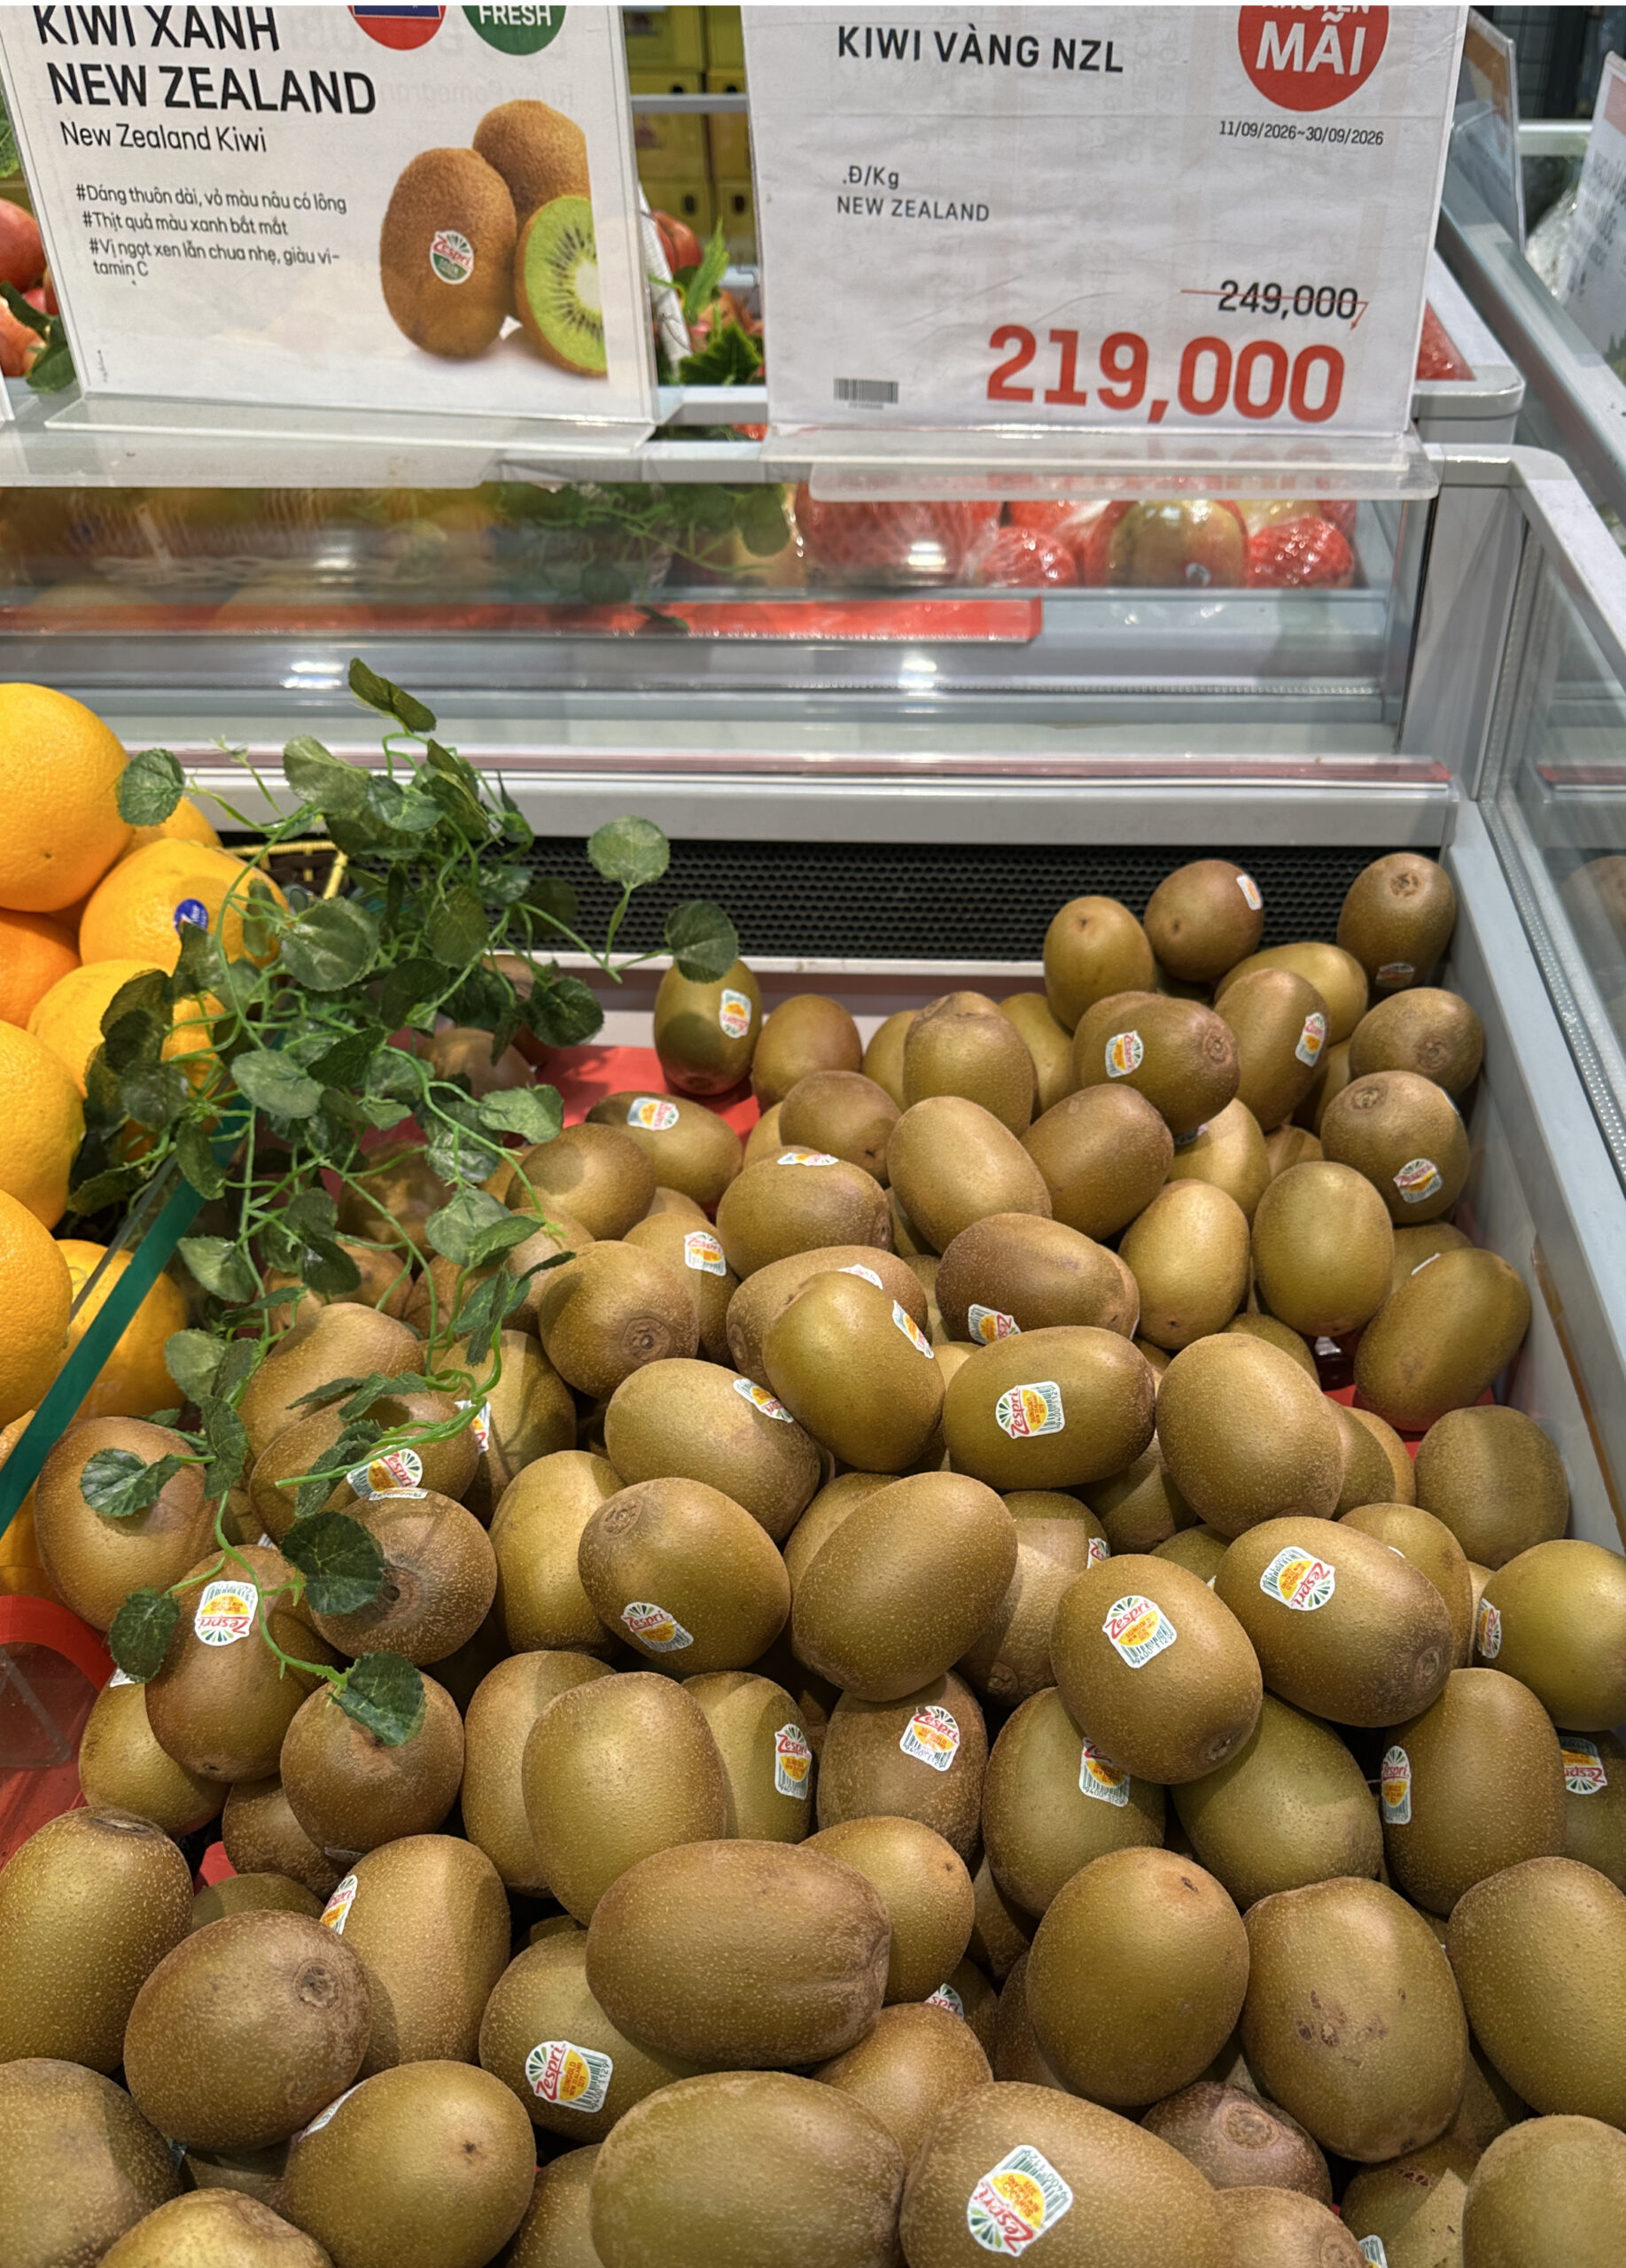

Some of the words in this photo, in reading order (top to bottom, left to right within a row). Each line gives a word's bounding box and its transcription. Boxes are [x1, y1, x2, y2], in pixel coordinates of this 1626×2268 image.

[33, 5, 136, 47] KIWI
[143, 5, 280, 51] XANH
[478, 5, 551, 27] FRESH
[837, 25, 922, 62] KIWI
[934, 23, 1040, 68] VÀNG
[1052, 37, 1124, 73] NZL
[1256, 11, 1366, 76] MÃI
[47, 62, 148, 107] NEW
[159, 65, 377, 114] ZEALAND
[60, 120, 112, 147] New
[115, 123, 212, 151] Zealand
[216, 126, 267, 152] Kiwi
[75, 183, 128, 206] #Dáng
[128, 186, 173, 204] thuôn
[204, 188, 222, 206] vỏ
[225, 189, 259, 207] màu
[261, 190, 291, 209] nâu
[293, 191, 311, 210] có
[314, 192, 347, 214] lông
[836, 195, 884, 217] NEW
[891, 199, 990, 222] ZEALAND
[82, 211, 123, 231] #Thịt
[125, 212, 153, 232] quả
[156, 214, 188, 231] màu
[190, 216, 228, 232] xanh
[93, 260, 135, 276] tamin
[136, 260, 149, 276] C
[118, 242, 152, 259] ngọt
[153, 244, 182, 258] xen
[208, 243, 245, 260] chua
[283, 246, 315, 267] giàu
[1218, 280, 1360, 321] 249,000
[986, 324, 1344, 423] 219,000
[1010, 1391, 1030, 1436] Zespri
[1292, 1562, 1330, 1608] Zespri
[198, 1615, 250, 1635] Zespri
[623, 1611, 666, 1631] Zespri
[1105, 1600, 1151, 1639] Zespri
[777, 1733, 808, 1755] Zespri
[914, 1712, 957, 1742] Zespri
[1564, 1767, 1606, 1783] Zespr
[535, 2045, 567, 2101] Zespri
[590, 2087, 603, 2108] 9400
[598, 2062, 610, 2084] 1129
[974, 2186, 1034, 2253] Zespri
